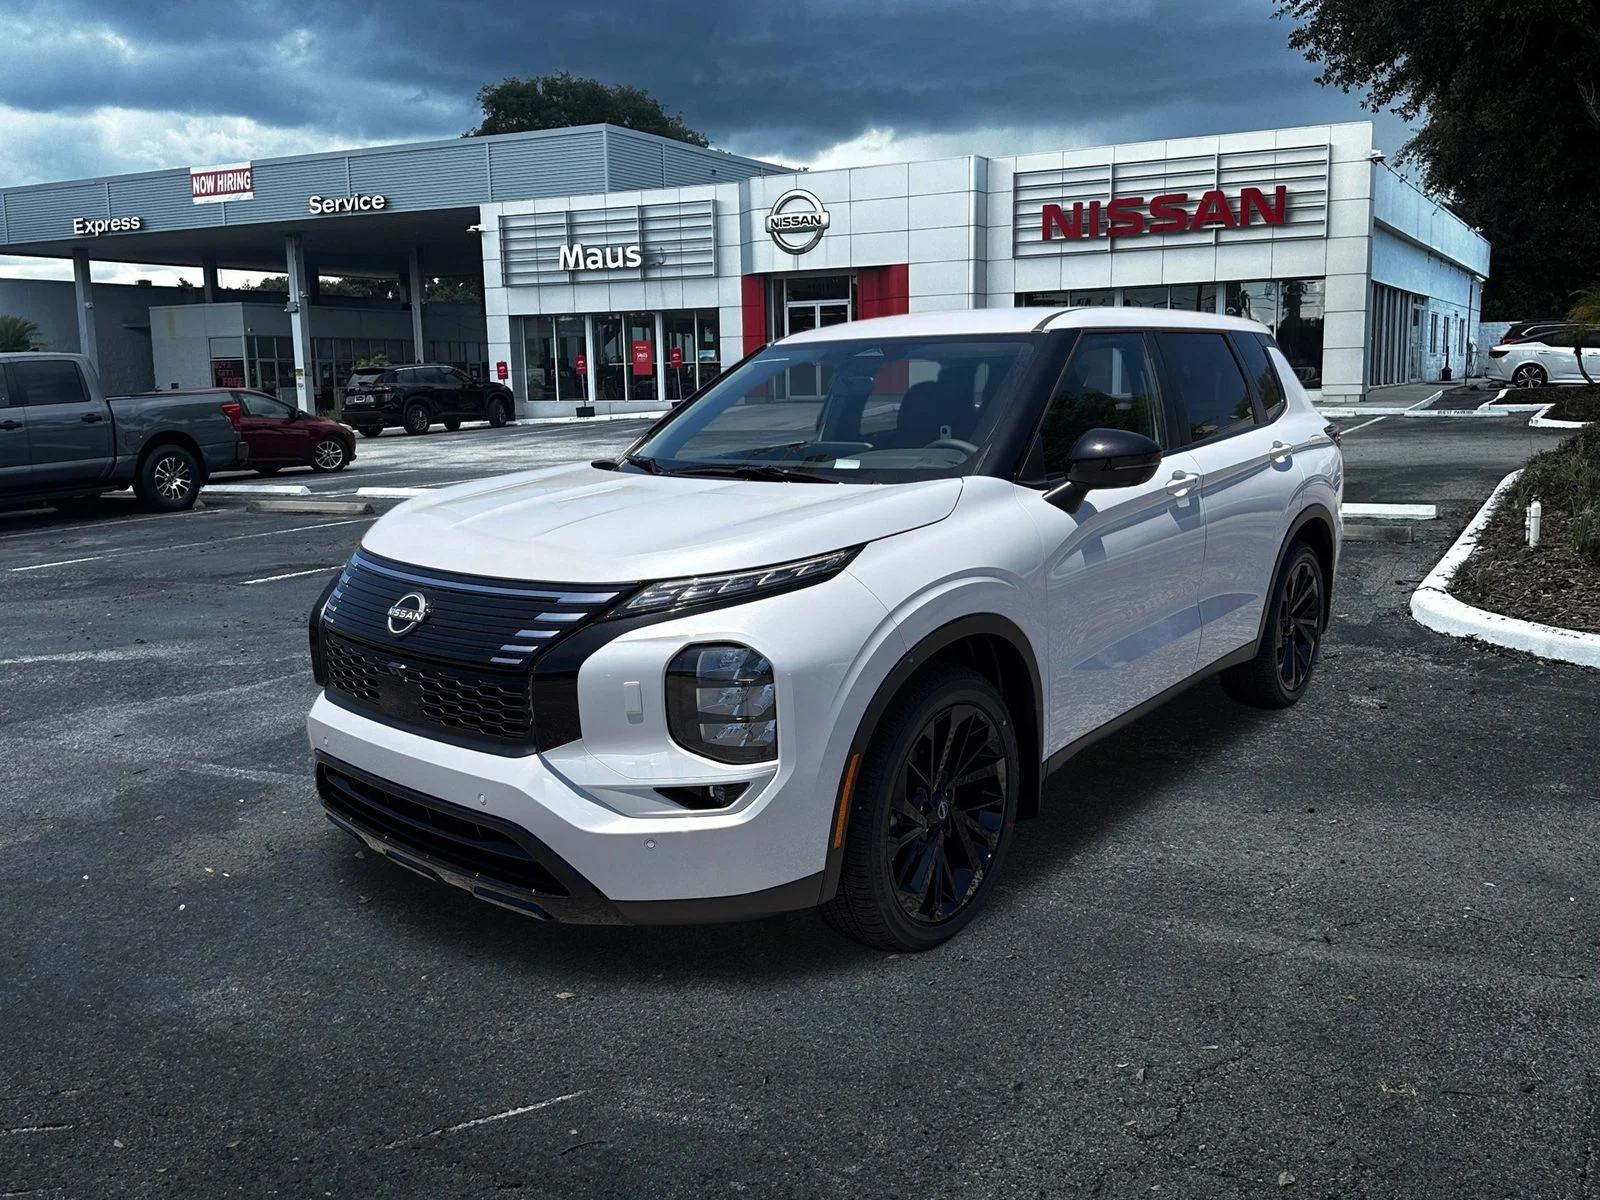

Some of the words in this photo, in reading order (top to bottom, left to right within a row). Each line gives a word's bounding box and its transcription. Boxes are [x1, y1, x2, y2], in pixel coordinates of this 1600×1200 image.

[192, 174, 215, 195] NOW
[217, 171, 251, 192] HIRING
[308, 193, 385, 214] Service
[1042, 185, 1287, 241] NISSAN
[73, 216, 141, 236] Express
[770, 214, 822, 228] NISSAN
[559, 243, 642, 270] Maus
[388, 606, 424, 621] NISSAN
